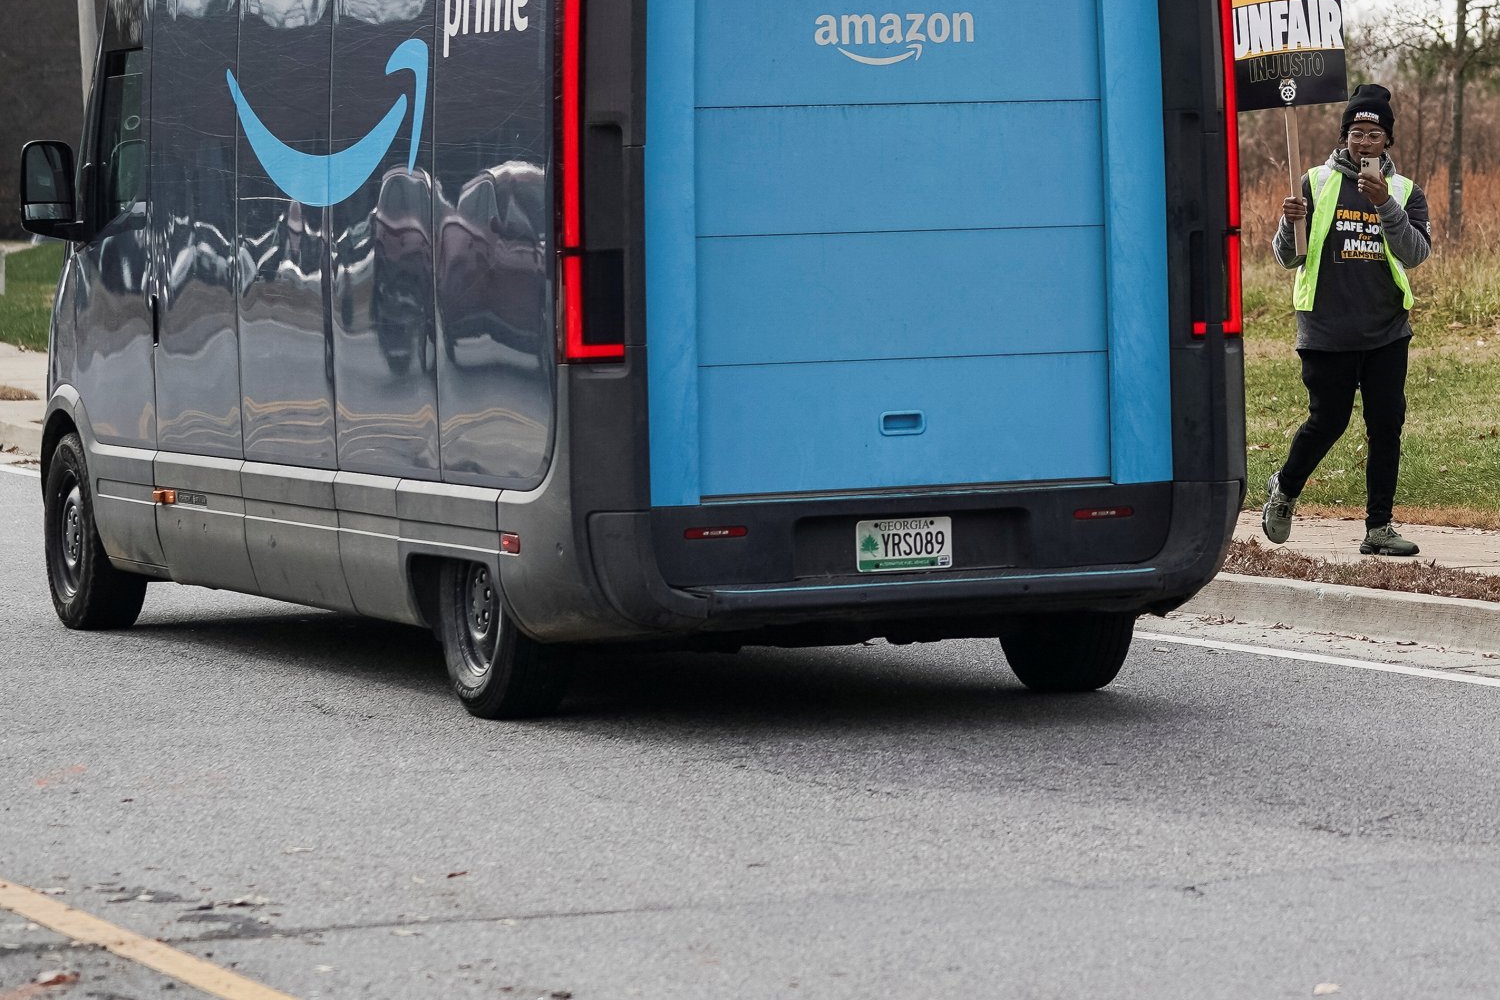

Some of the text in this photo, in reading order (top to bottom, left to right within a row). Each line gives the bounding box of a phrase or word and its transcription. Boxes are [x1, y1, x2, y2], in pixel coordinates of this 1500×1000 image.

[814, 11, 975, 46] amazon
[1249, 51, 1325, 84] INJUSTO
[1337, 209, 1361, 221] FAIR
[1336, 220, 1364, 233] SAFE
[1358, 233, 1373, 241] for
[878, 519, 931, 532] GEORGIA
[881, 530, 946, 557] YRS089
